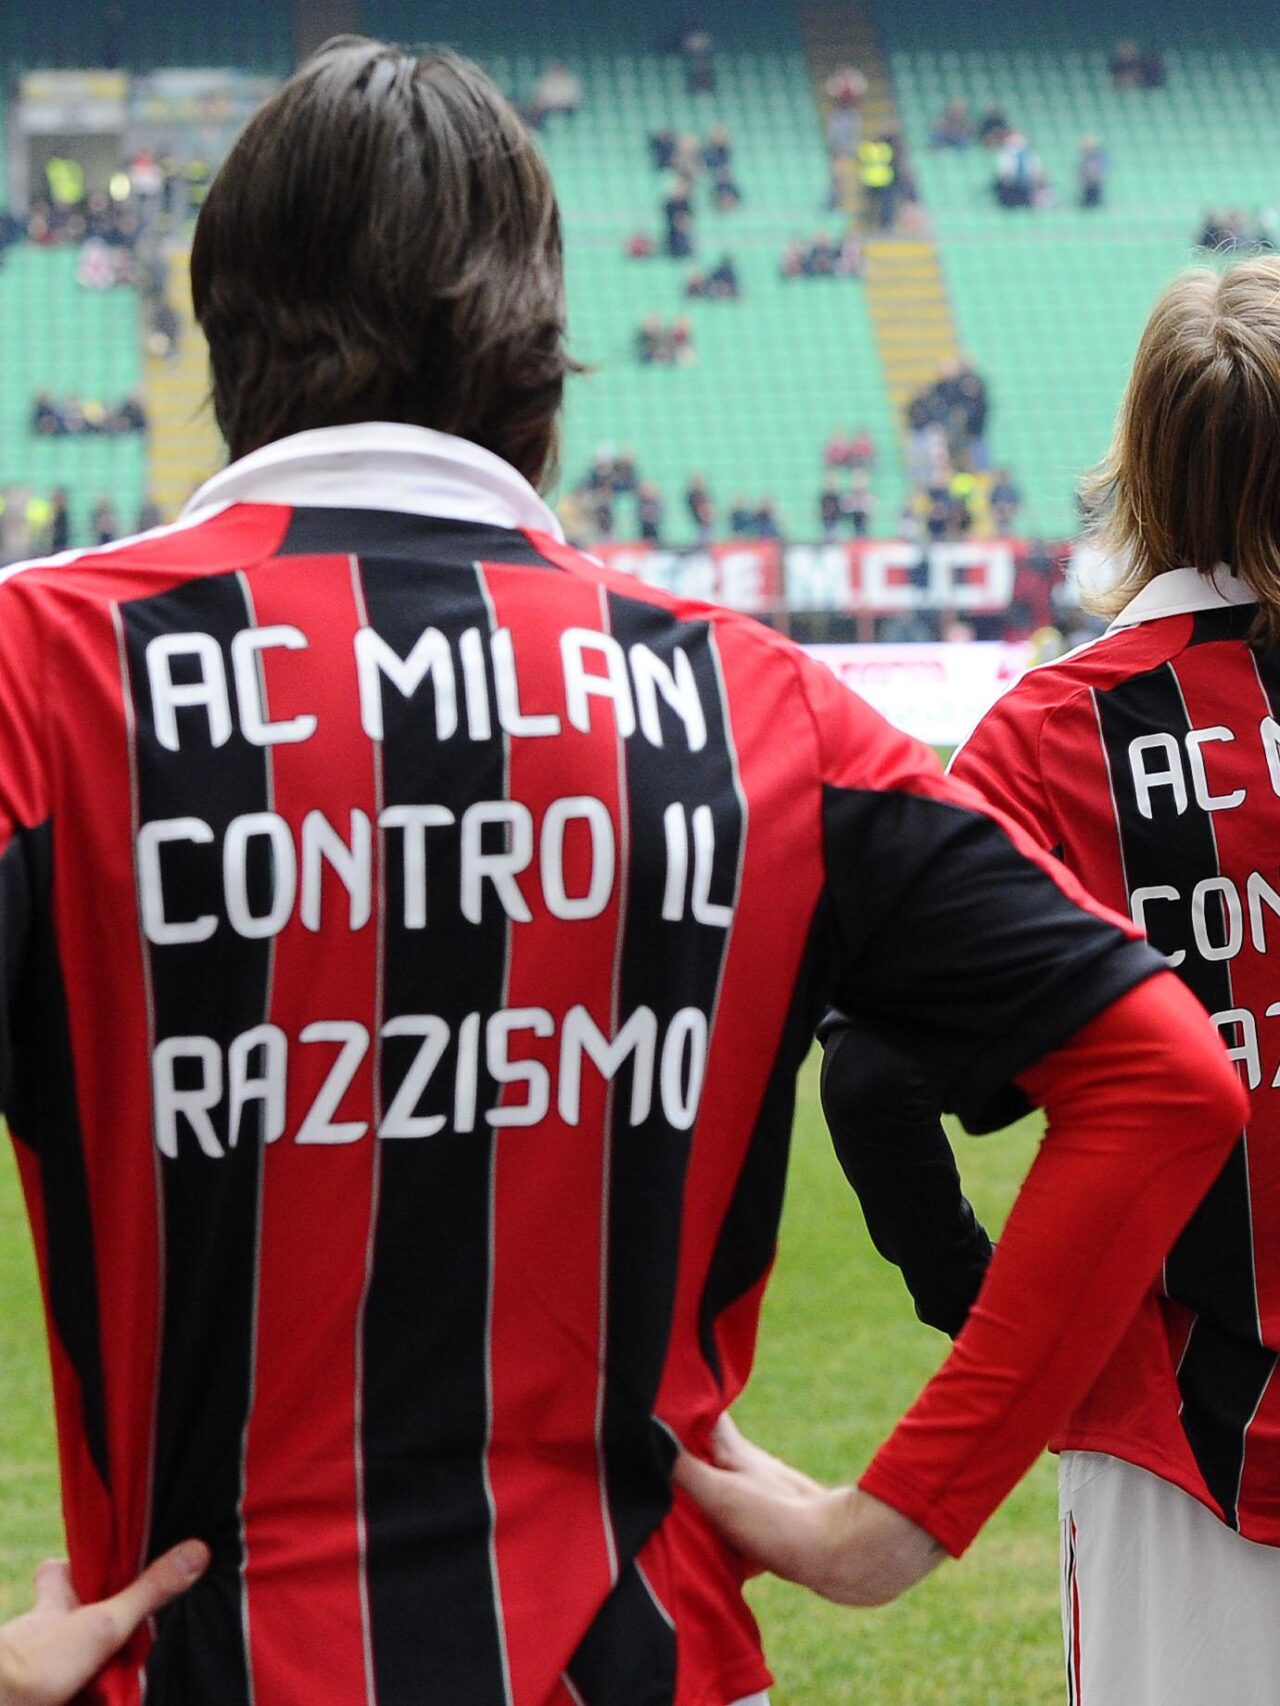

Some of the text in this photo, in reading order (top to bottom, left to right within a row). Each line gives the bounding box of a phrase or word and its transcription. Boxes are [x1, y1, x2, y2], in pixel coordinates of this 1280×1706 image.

[145, 626, 706, 751] AC MILAN
[1128, 726, 1246, 819] AC
[137, 796, 733, 945] CONTRO IL
[153, 1006, 707, 1158] RAZZISMO
